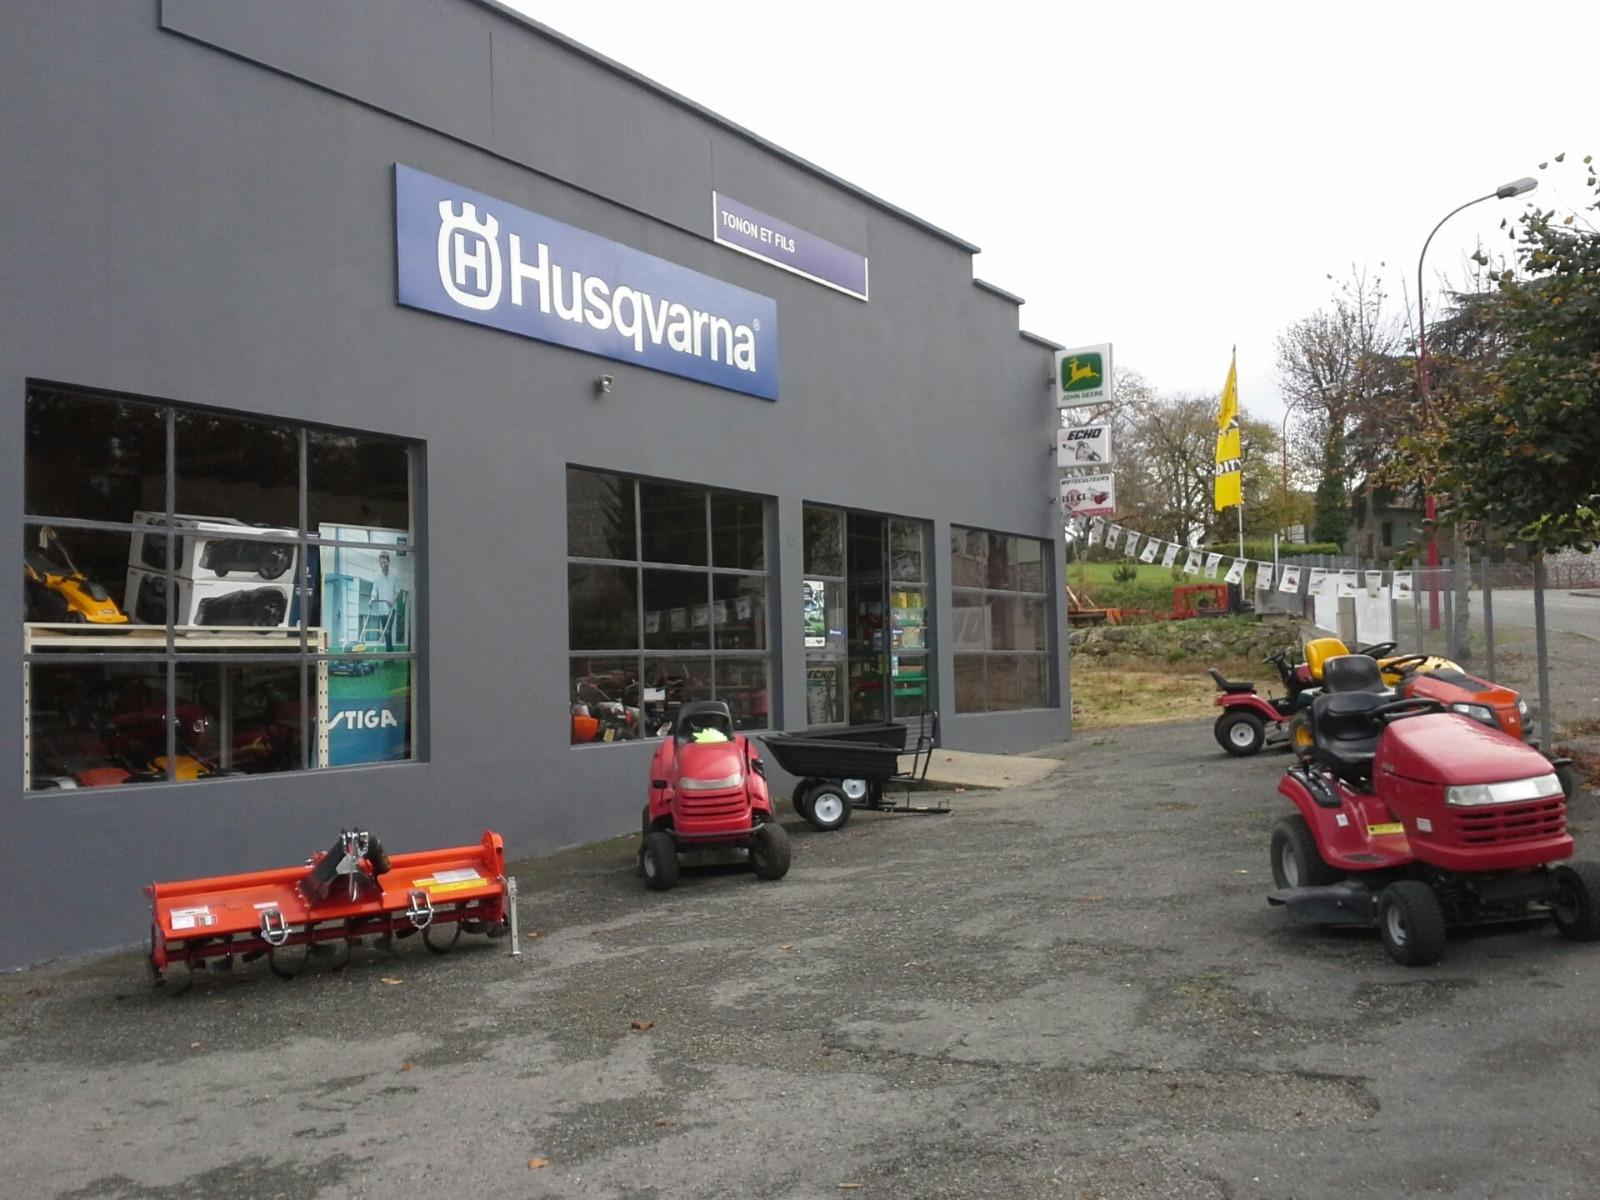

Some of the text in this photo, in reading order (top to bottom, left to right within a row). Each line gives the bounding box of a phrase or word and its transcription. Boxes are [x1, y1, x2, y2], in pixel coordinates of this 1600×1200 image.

[721, 210, 796, 253] TONON ET FILS
[509, 232, 756, 373] Husqvarna
[1062, 390, 1104, 401] JOHN DEERE
[1067, 428, 1103, 441] ECHO
[328, 709, 398, 730] STIGA
